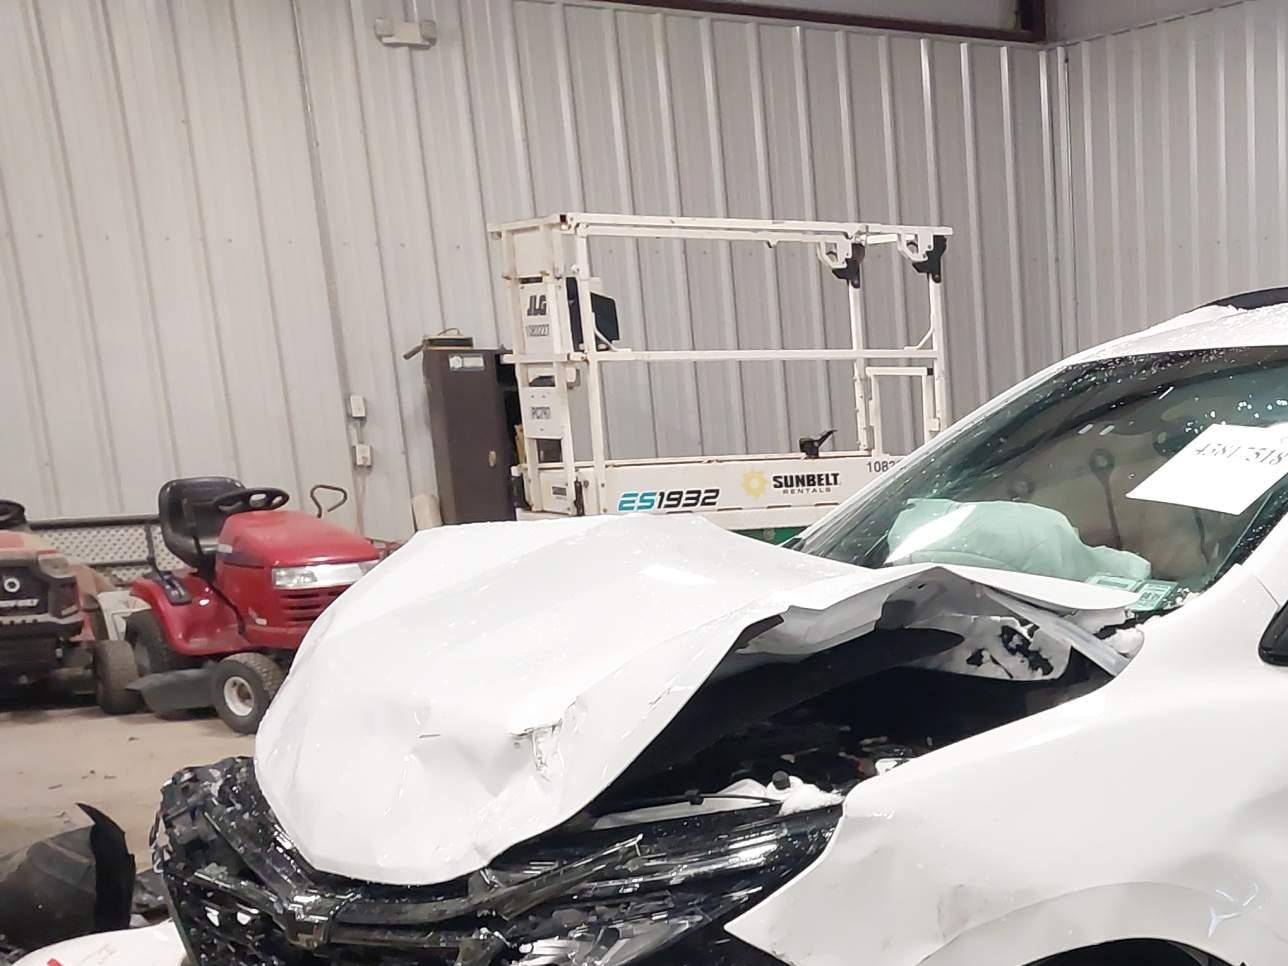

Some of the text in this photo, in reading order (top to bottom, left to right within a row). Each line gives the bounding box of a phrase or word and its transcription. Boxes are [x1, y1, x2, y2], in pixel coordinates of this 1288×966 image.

[527, 294, 547, 316] JLG
[772, 472, 840, 489] SUNBELT
[618, 488, 720, 511] ES1932
[782, 487, 832, 495] RENTALS
